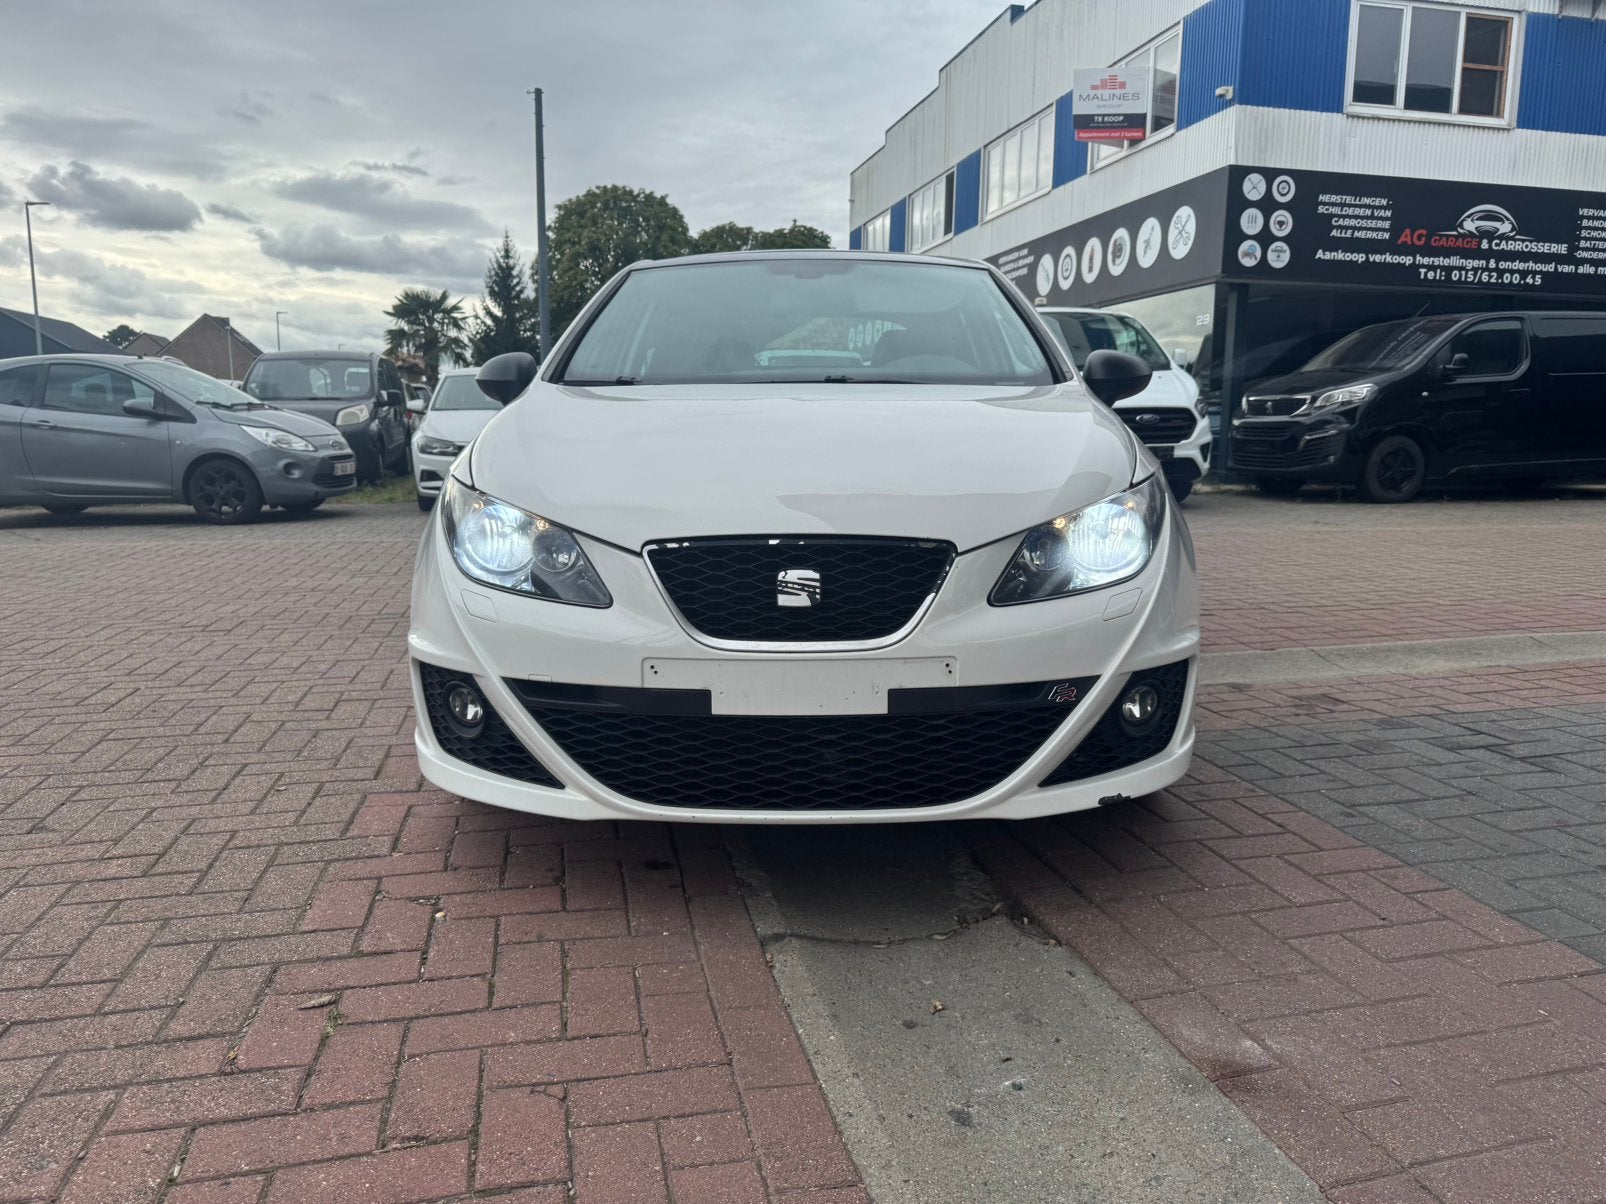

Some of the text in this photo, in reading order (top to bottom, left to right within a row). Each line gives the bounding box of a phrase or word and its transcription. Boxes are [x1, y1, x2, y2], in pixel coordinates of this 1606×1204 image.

[1079, 93, 1141, 102] MALINES
[1318, 194, 1388, 206] HERSTELLINGEN
[1317, 205, 1392, 218] SCHILDEREN VAN
[1331, 217, 1391, 229] CARROSSERIE
[1329, 229, 1390, 240] ALLE MERKEN
[1396, 228, 1569, 254] AG GARAGE & CARROSSERIE
[1314, 249, 1366, 264] Aankoop
[1368, 252, 1413, 266] verkoop
[1415, 253, 1486, 269] herstellingen
[1488, 258, 1496, 269] &
[1498, 260, 1555, 272] onderhoud
[1557, 264, 1575, 273] van
[1577, 263, 1596, 274] alle
[1419, 268, 1542, 285] Tel: 015/62.00.45
